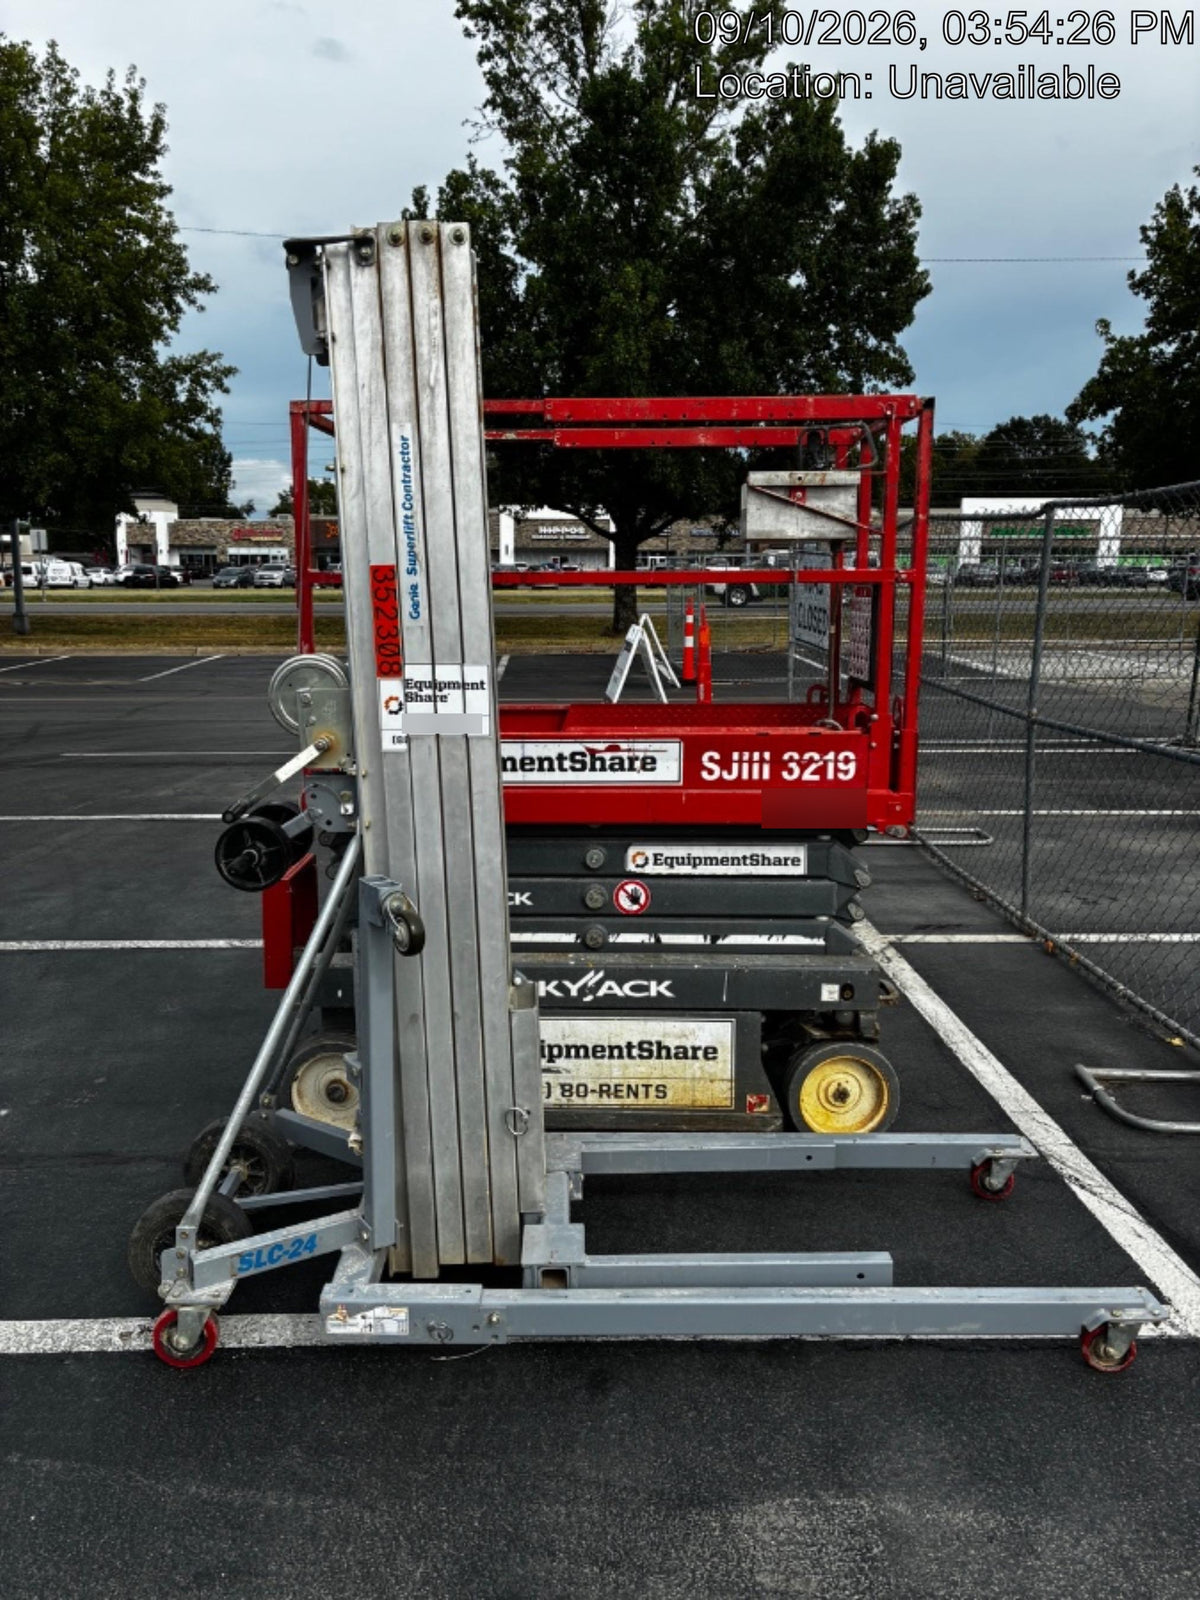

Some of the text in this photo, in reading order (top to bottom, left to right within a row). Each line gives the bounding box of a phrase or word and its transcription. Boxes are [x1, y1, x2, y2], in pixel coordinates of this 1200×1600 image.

[399, 434, 421, 620] Genie Superlift Contractor
[372, 567, 403, 677] 352308
[781, 750, 857, 782] 3219
[652, 852, 802, 869] EquipmentShare
[237, 1232, 318, 1275] SLC-24
